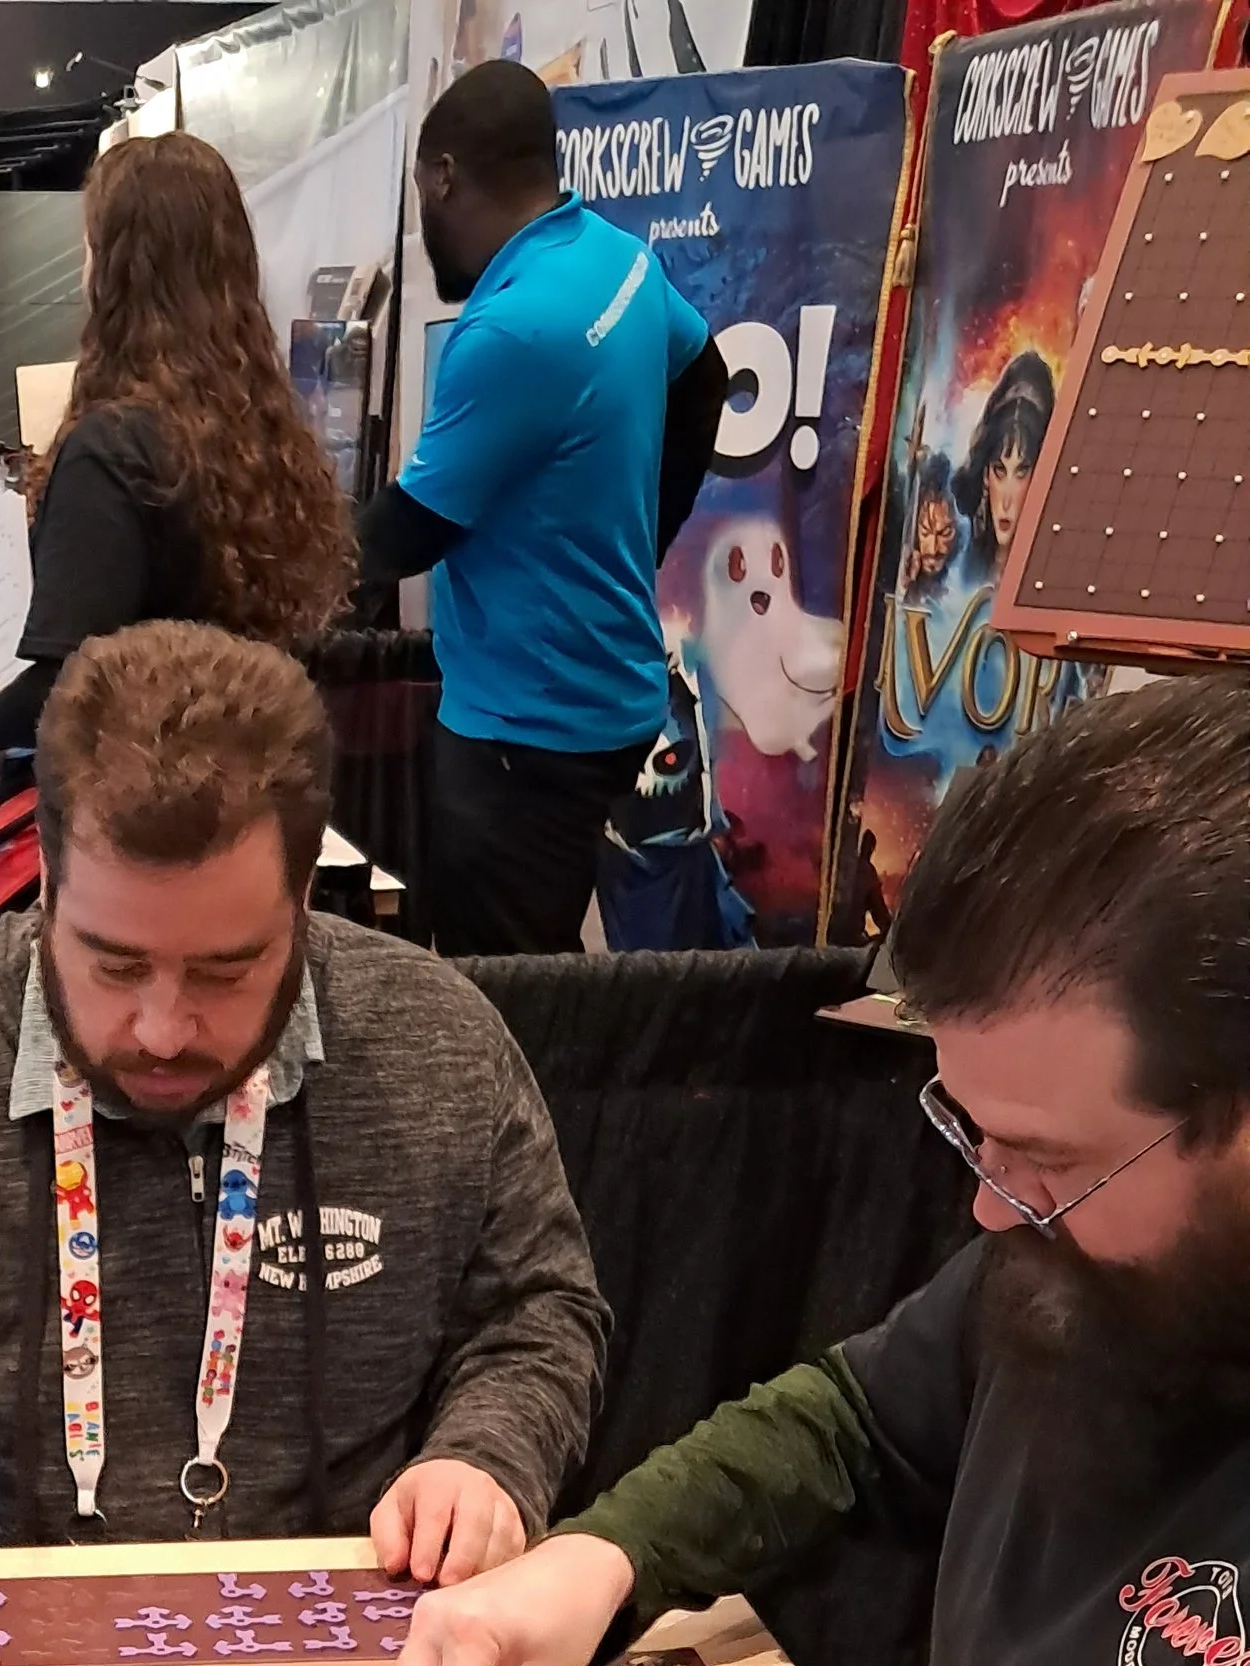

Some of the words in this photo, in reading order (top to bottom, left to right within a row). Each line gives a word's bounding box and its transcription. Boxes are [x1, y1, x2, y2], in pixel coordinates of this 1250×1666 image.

[953, 38, 1070, 145] CORKSCREW
[1090, 20, 1160, 129] GAMES
[734, 102, 820, 189] GAMES
[999, 138, 1073, 208] presents
[649, 201, 720, 247] presents
[258, 1215, 287, 1251] MT.
[287, 1207, 382, 1245] WHINGTON
[259, 1262, 295, 1290] NEW
[277, 1244, 307, 1264] ELE
